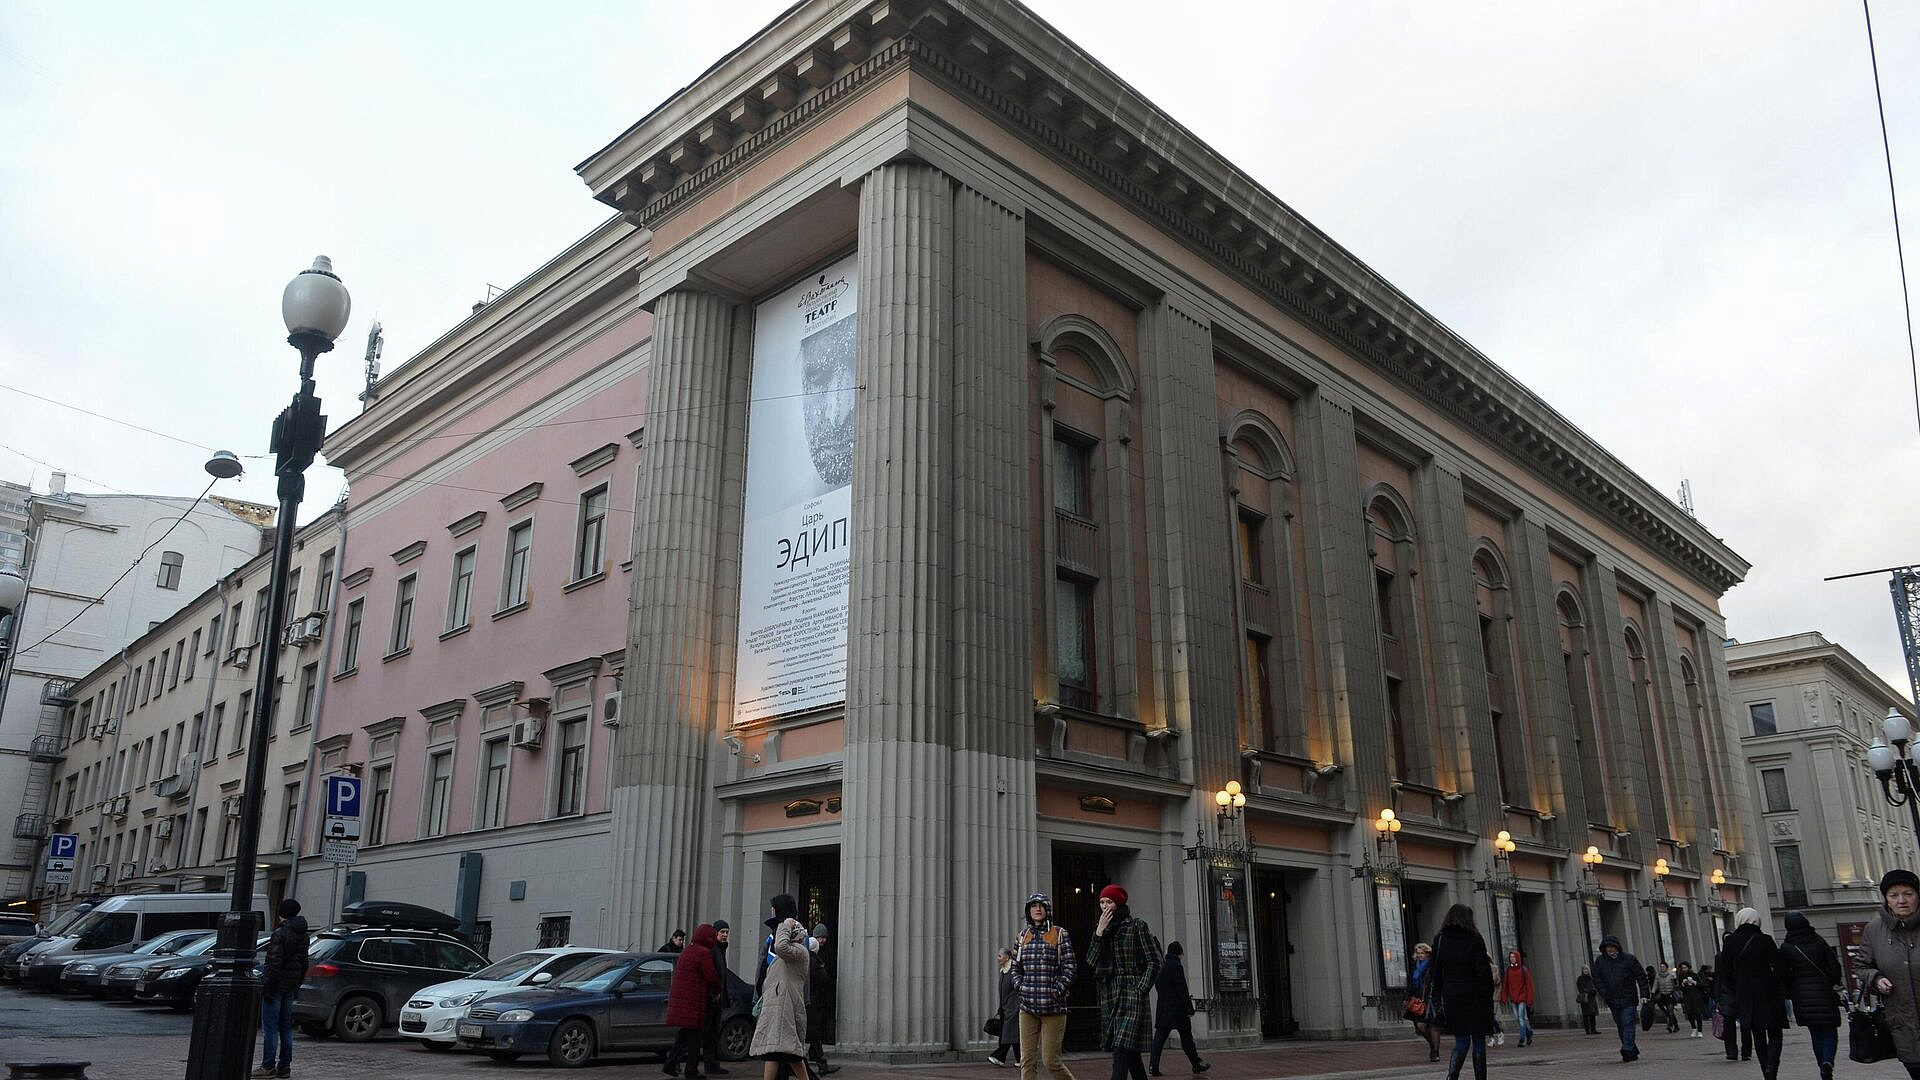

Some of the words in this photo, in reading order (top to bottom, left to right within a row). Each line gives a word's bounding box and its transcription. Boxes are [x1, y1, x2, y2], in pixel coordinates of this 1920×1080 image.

[805, 300, 837, 324] ТЕАТР
[803, 500, 822, 510] Софокл
[802, 512, 823, 527] Царь
[777, 517, 847, 572] ЭДИП
[337, 781, 355, 812] P
[57, 837, 73, 855] P
